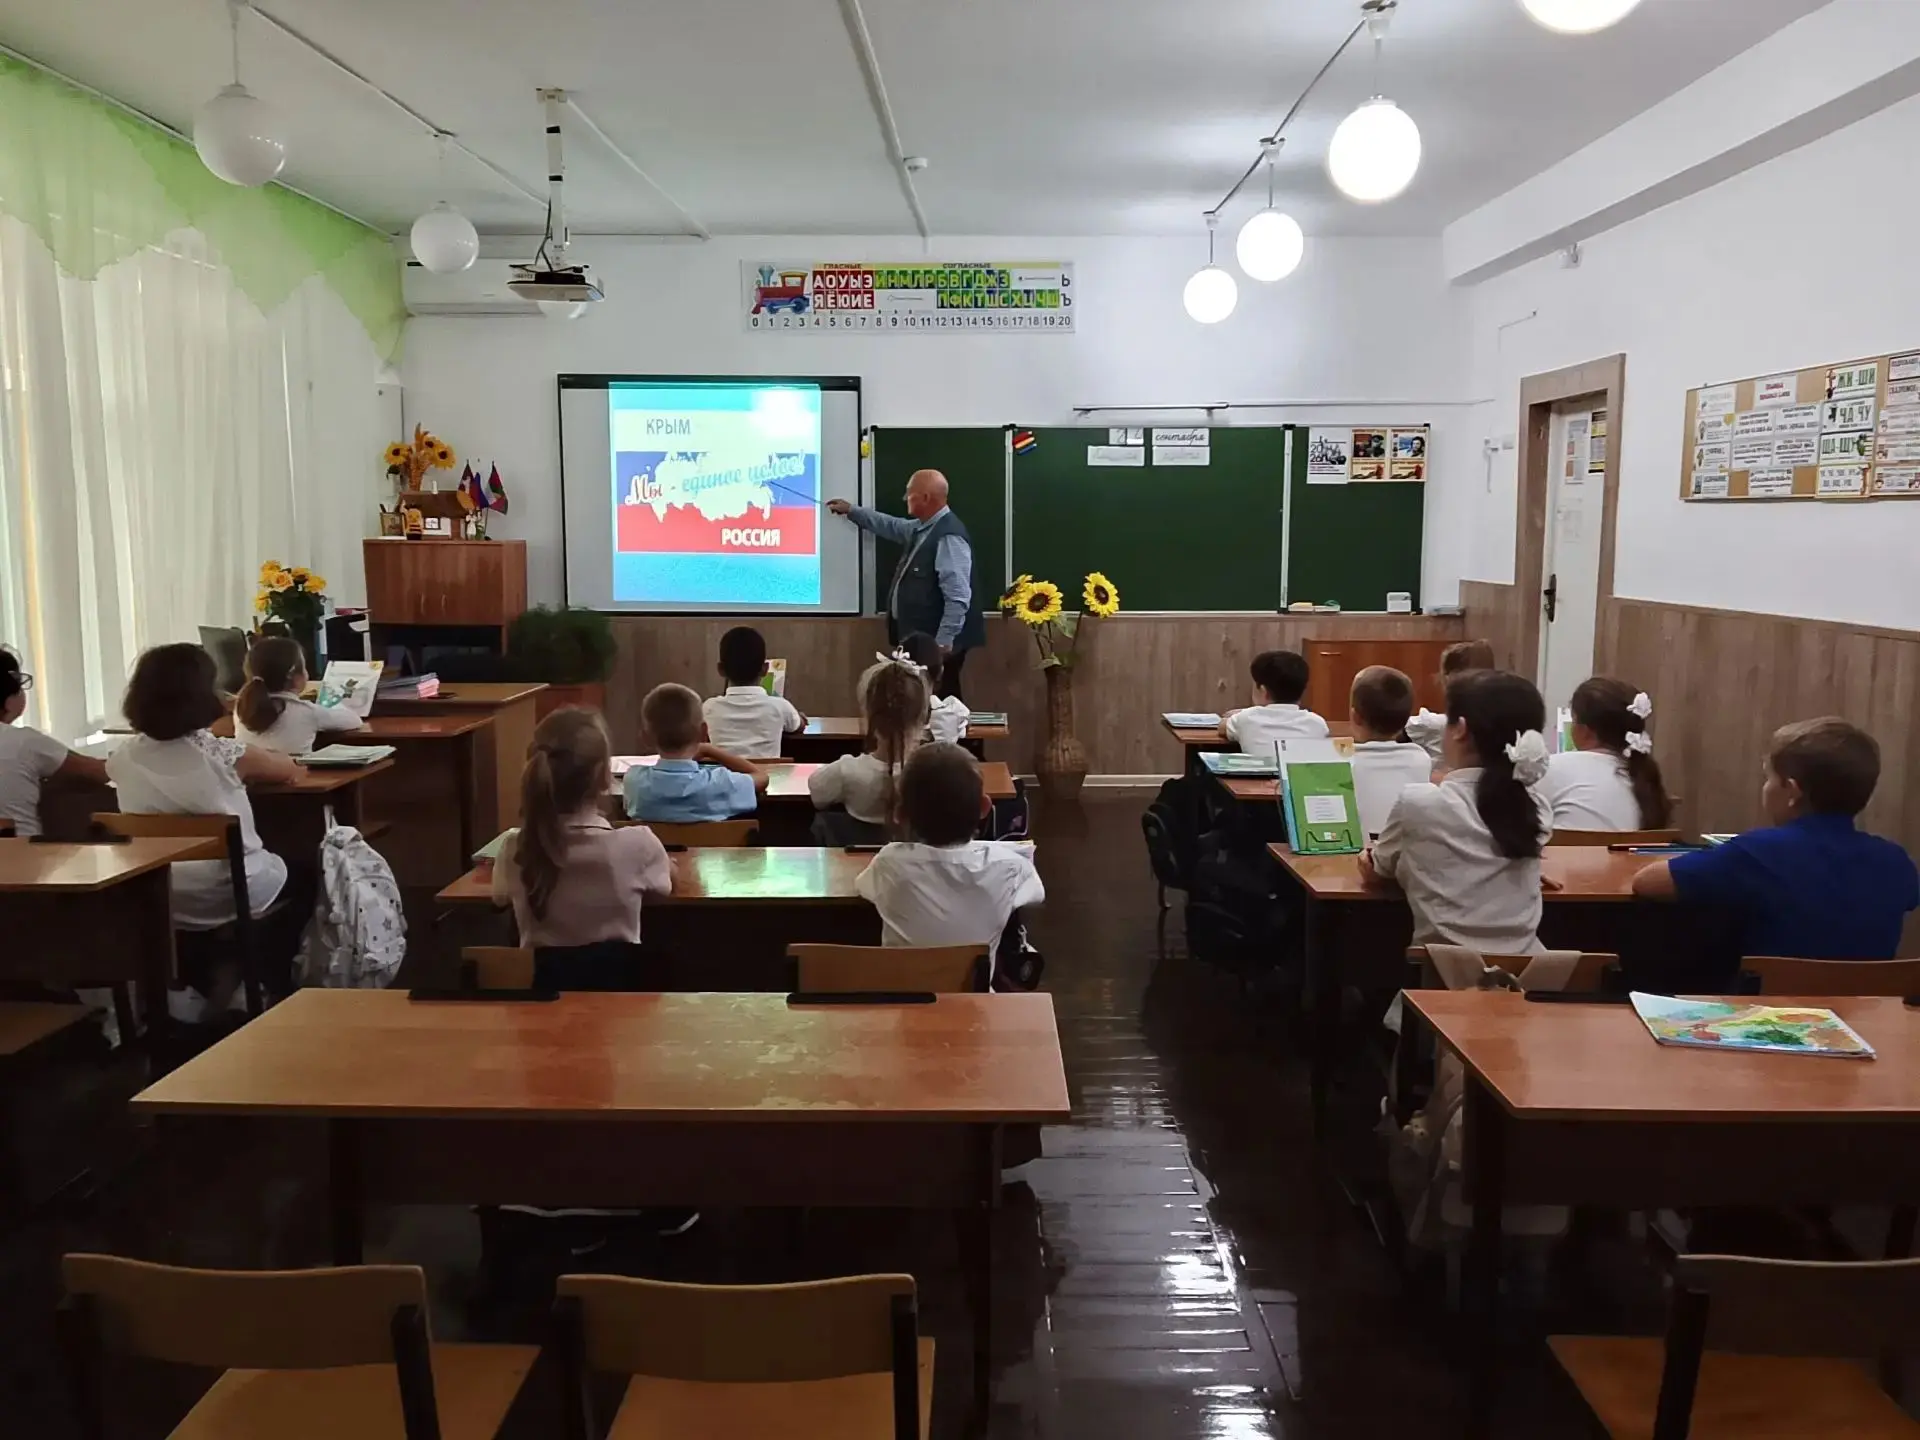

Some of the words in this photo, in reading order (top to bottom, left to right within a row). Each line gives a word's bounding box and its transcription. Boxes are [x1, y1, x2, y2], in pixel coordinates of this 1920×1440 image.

[752, 317, 759, 327] 0
[769, 317, 774, 327] 1
[783, 317, 790, 327] 2
[799, 317, 805, 327] 3
[814, 317, 820, 327] 4
[829, 317, 836, 327] 5
[845, 317, 851, 327] 6
[860, 317, 866, 327] 7
[876, 317, 882, 327] 8
[891, 317, 898, 327] 9
[904, 316, 916, 326] 10
[920, 316, 931, 326] 11
[935, 316, 947, 326] 12
[951, 316, 962, 326] 13
[966, 316, 978, 326] 14
[981, 316, 993, 326] 15
[997, 316, 1009, 326] 16
[1012, 316, 1023, 326] 17
[1027, 316, 1039, 326] 18
[1043, 316, 1055, 326] 19
[1058, 316, 1070, 326] 20
[646, 418, 691, 435] КРЫМ
[721, 528, 781, 547] РОССИЯ
